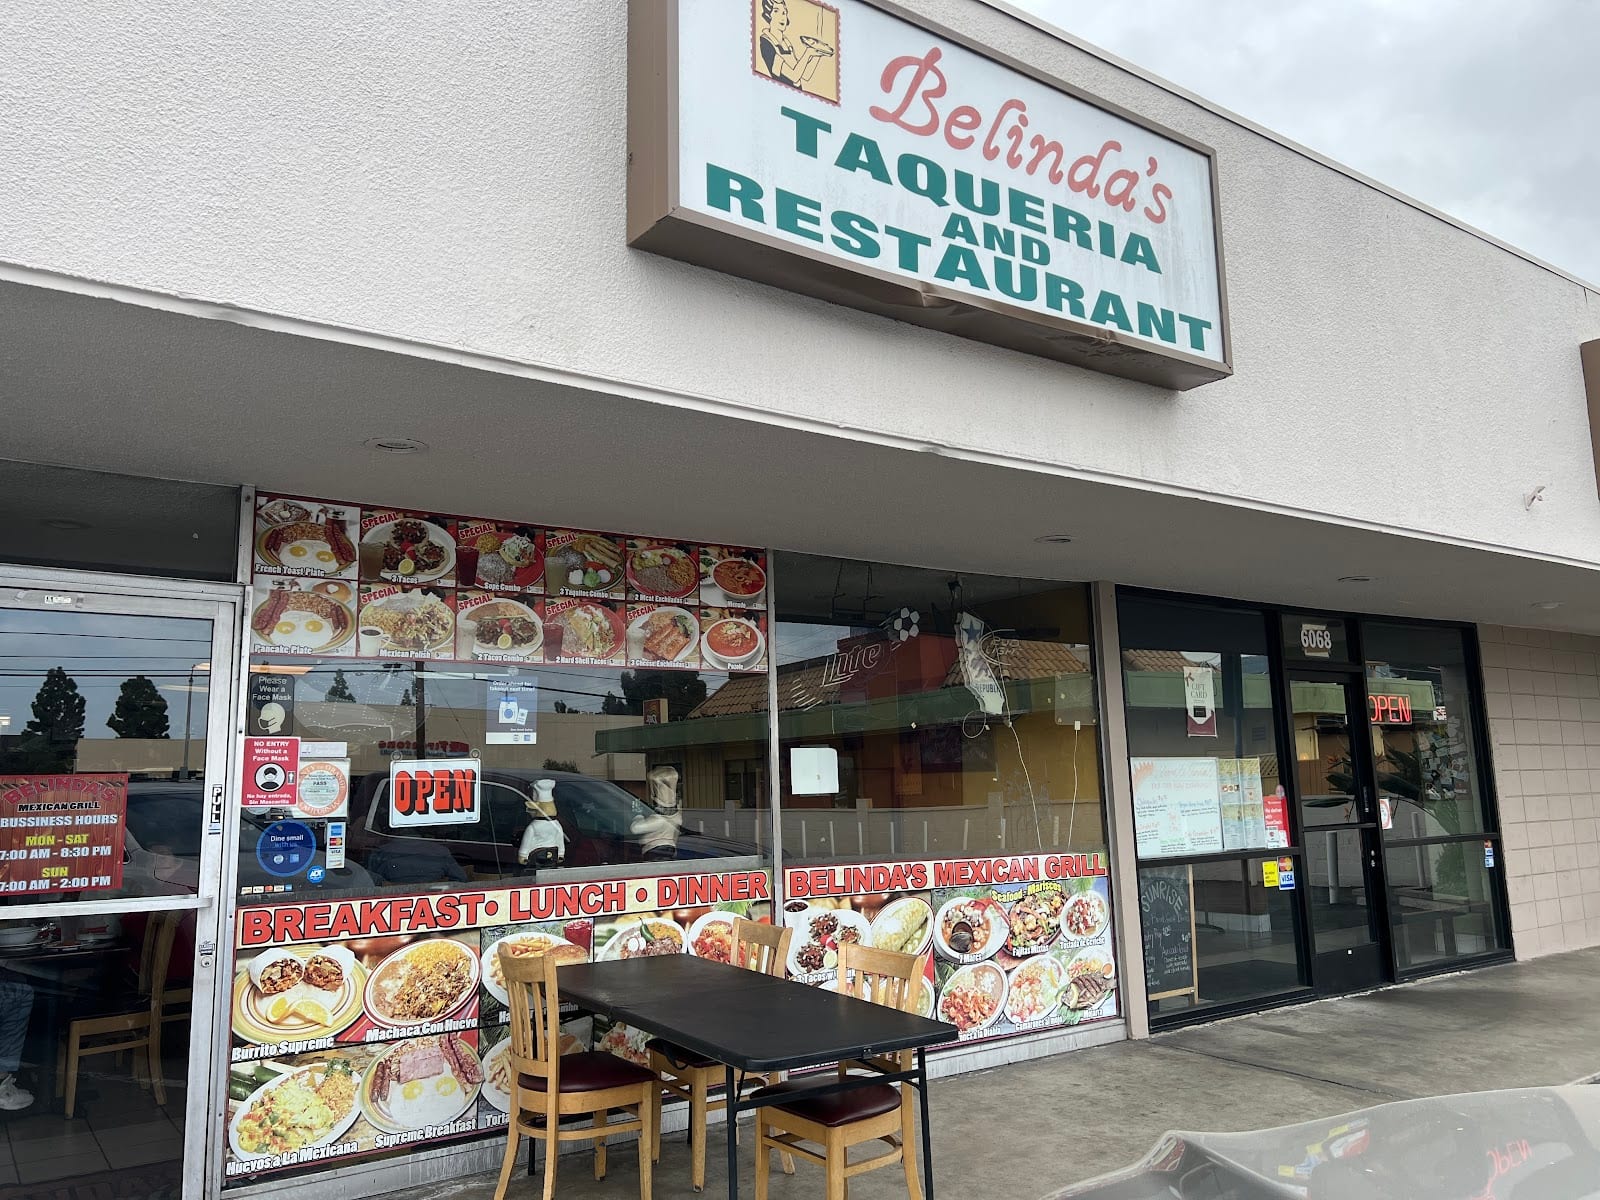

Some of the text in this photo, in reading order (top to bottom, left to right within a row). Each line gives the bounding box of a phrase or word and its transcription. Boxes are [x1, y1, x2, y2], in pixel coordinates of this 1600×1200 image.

[869, 46, 1173, 224] Belinda's
[780, 105, 1163, 275] TAQUERIA
[942, 212, 1051, 267] AND
[706, 162, 1212, 351] RESTAURANT
[361, 511, 399, 529] SPECIAL
[459, 522, 494, 540] SPECIAL
[546, 532, 578, 549] SPECIAL
[255, 563, 326, 577] French Toast Plate
[391, 575, 419, 585] 3 Tacos
[501, 583, 521, 592] Combo
[361, 585, 399, 603] SPECIAL
[590, 590, 609, 599] Combo
[459, 594, 493, 611] SPECIAL
[546, 600, 577, 616] SPECIAL
[627, 604, 657, 620] SPECIAL
[1301, 629, 1331, 649] 6068
[254, 645, 313, 654] Pancake Plate
[379, 650, 408, 659] Mexican
[502, 654, 524, 663] Combo
[591, 657, 607, 665] Tacos
[258, 676, 287, 685] Please
[272, 693, 292, 701] Mask
[1368, 695, 1411, 722] OPEN
[395, 769, 476, 816] OPEN
[69, 802, 100, 810] GRILL
[211, 787, 222, 823] PULL
[0, 814, 118, 827] BUSSINESS HOURS
[25, 836, 55, 846] MON
[65, 834, 88, 844] SAT
[0, 850, 27, 860] 7:00
[29, 849, 50, 859] AM
[60, 847, 89, 858] 8:30
[92, 846, 111, 856] PM
[42, 867, 68, 878] SUN
[789, 853, 1105, 897] BELINDA'S MEXICAN GRILL
[0, 881, 27, 892] 7:00
[29, 880, 50, 891] AM
[60, 878, 88, 889] 2:00
[92, 876, 111, 887] PM
[991, 889, 1022, 903] Seafood
[1027, 881, 1062, 896] Mariscos
[1141, 881, 1183, 913] SUNRISE
[242, 872, 769, 945] BREAKFAST LUNCH DINNER
[1012, 947, 1030, 957] Fajitas
[1060, 939, 1080, 950] Tostada
[964, 953, 982, 962] Mares
[804, 973, 824, 983] Tacos
[366, 1017, 478, 1042] Machaca Con Huevo
[231, 1037, 334, 1061] Burrito Supreme
[375, 1118, 476, 1149] Supreme Breakfast
[226, 1140, 358, 1176] Huevos a La Mexicana
